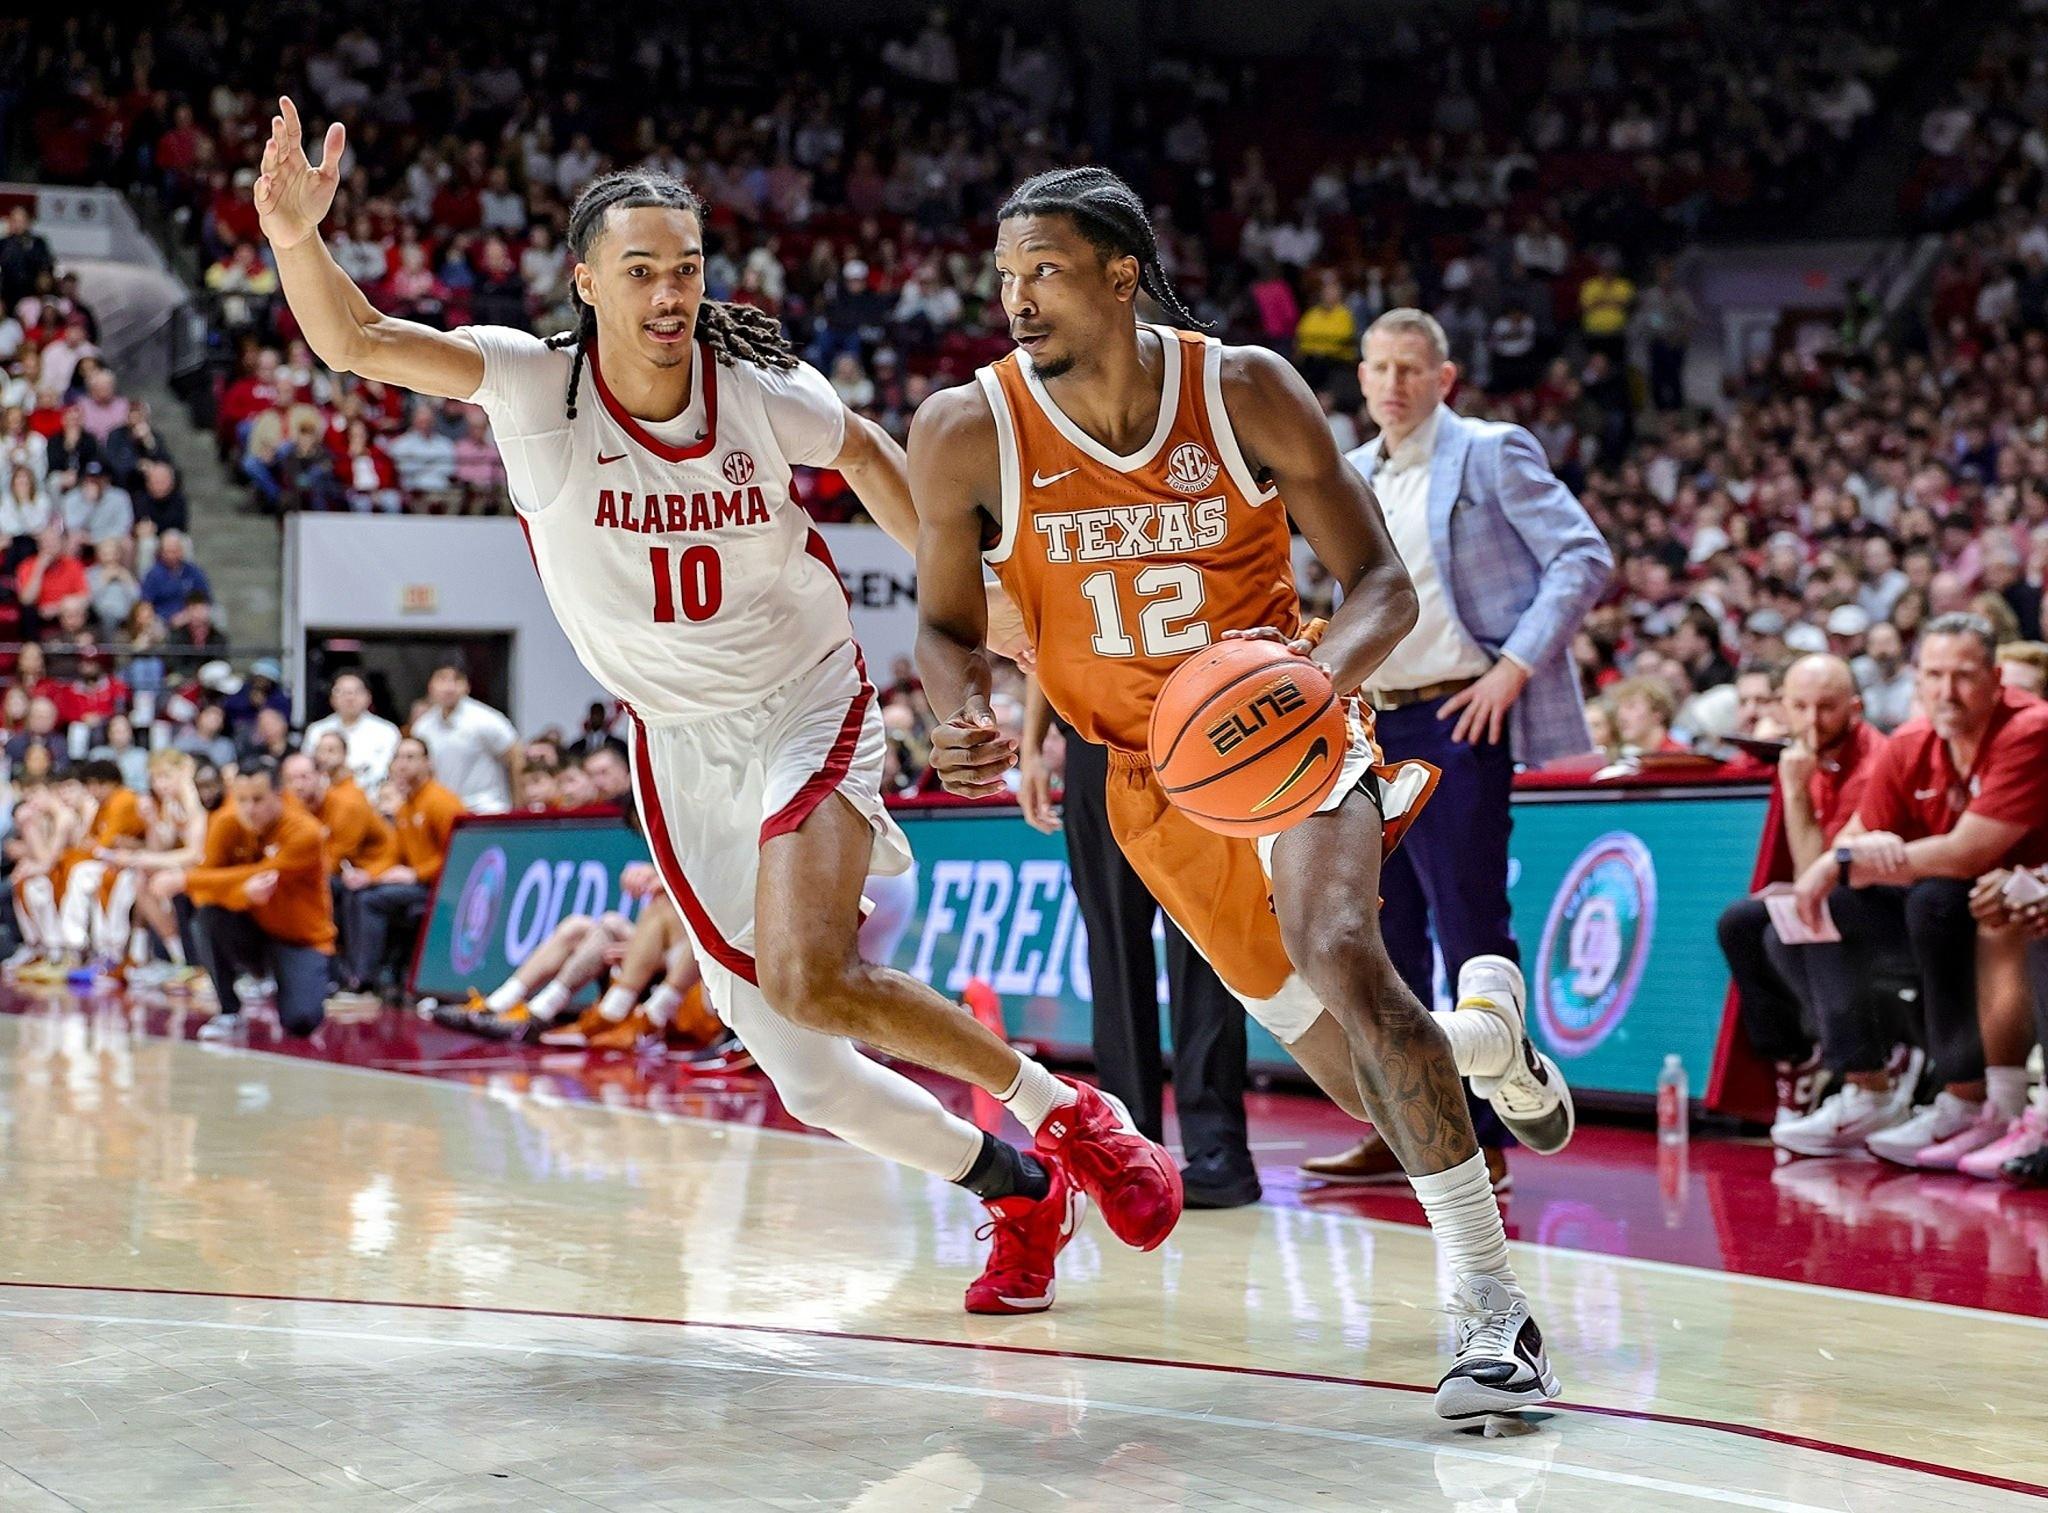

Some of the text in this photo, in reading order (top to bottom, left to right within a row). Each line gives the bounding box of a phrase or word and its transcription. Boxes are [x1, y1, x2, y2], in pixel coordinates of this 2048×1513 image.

[723, 453, 754, 484] SEC
[1172, 446, 1207, 481] SEC
[1172, 470, 1216, 492] GRADUATE
[595, 487, 770, 533] ALABAMA
[1034, 496, 1227, 563] TEXAS
[649, 545, 722, 623] 10
[1081, 563, 1211, 657] 12
[1206, 682, 1307, 757] ELITE
